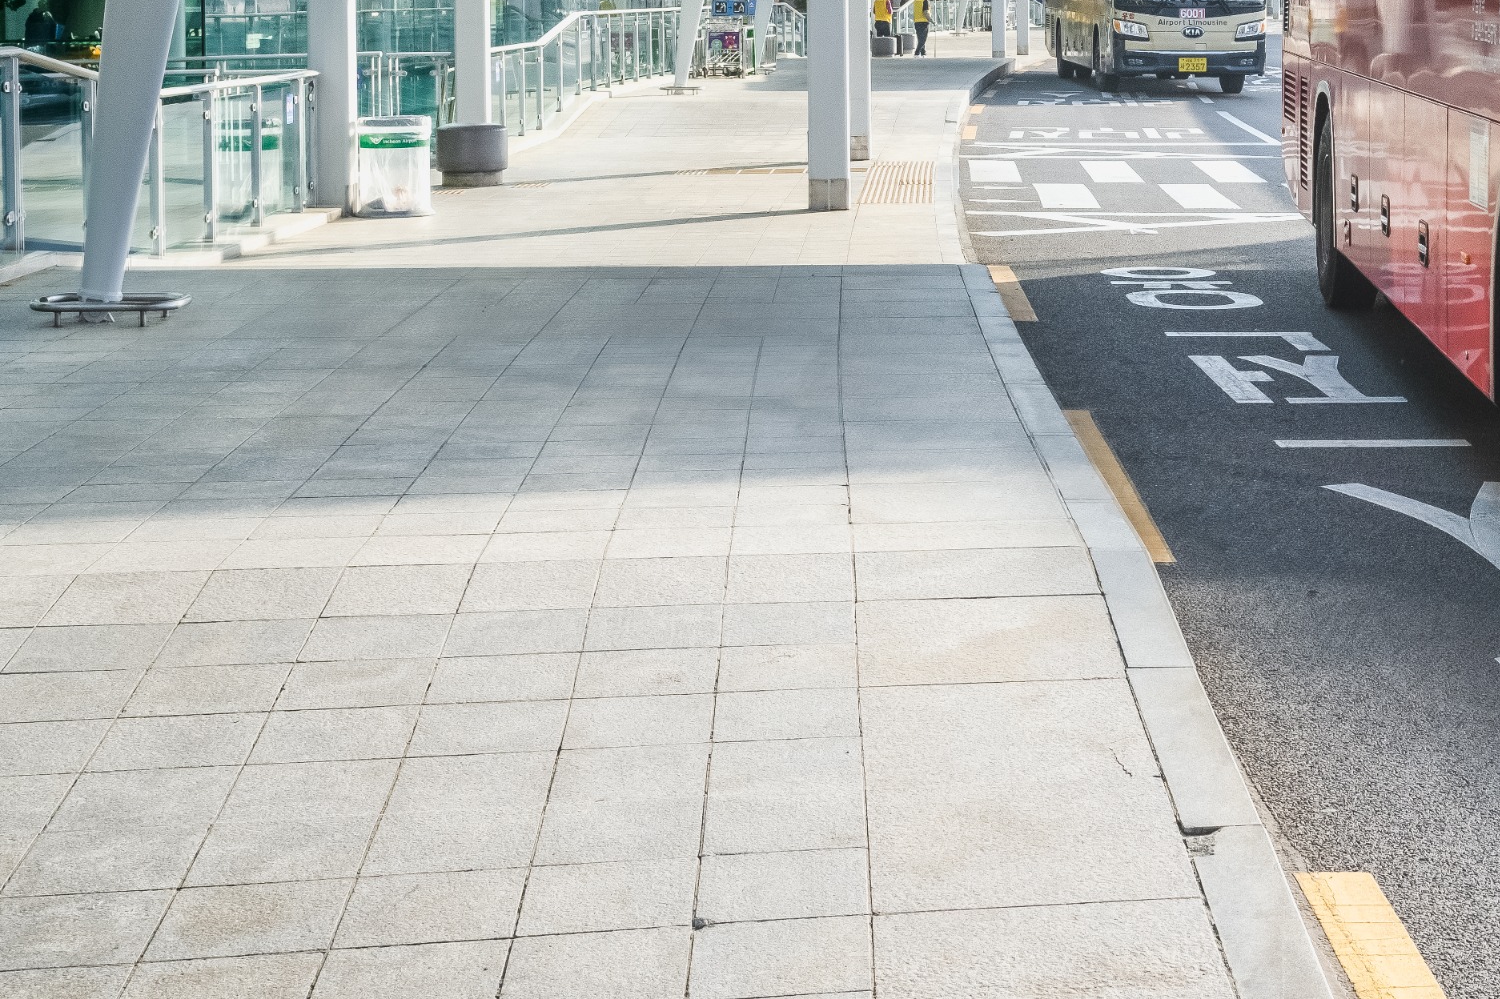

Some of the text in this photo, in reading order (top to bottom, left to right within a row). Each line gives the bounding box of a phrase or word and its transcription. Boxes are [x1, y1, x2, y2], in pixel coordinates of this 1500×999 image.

[1180, 8, 1204, 18] 6001
[1157, 19, 1186, 27] Airport
[1185, 28, 1201, 36] KIA
